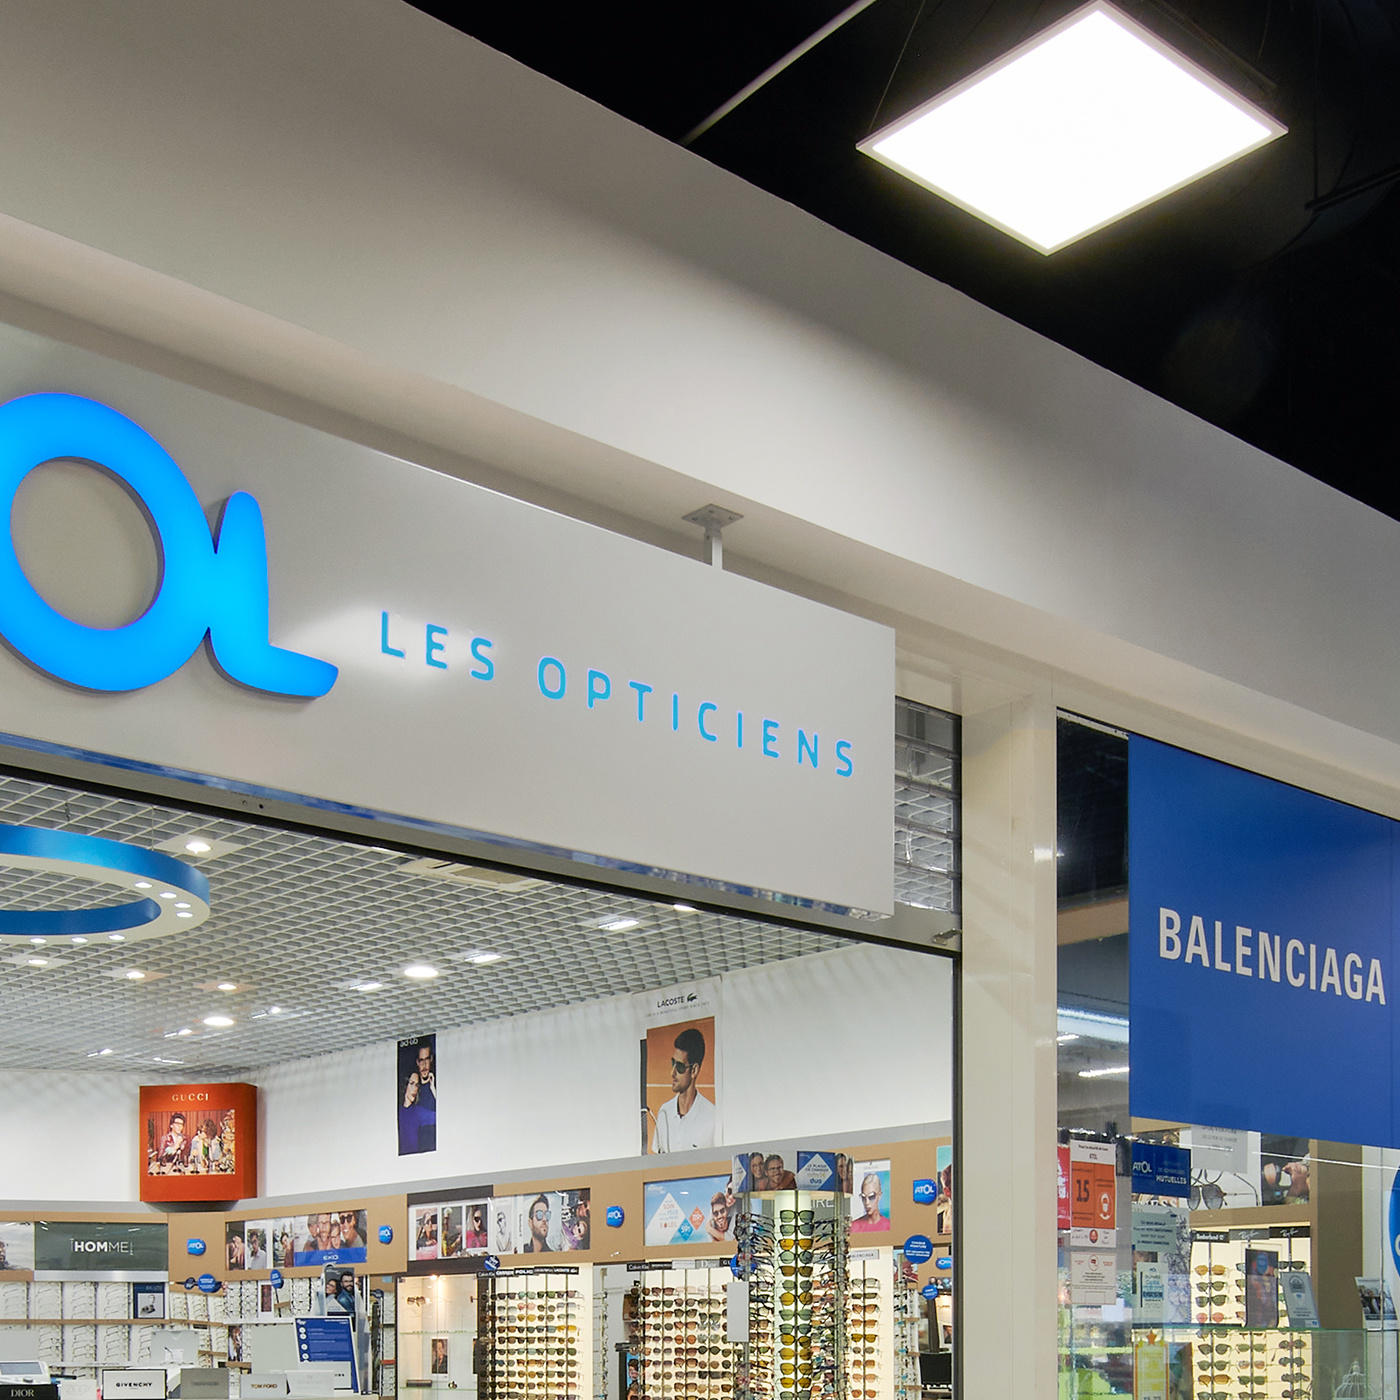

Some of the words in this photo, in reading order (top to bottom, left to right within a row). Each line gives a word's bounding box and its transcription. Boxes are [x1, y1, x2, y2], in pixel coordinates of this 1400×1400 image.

[378, 609, 497, 684] LES
[536, 655, 857, 779] OPTICIENS
[1158, 907, 1387, 1006] BALENCIAGA
[172, 1093, 209, 1101] GUCCI
[1133, 1161, 1152, 1173] ATOL
[74, 1240, 129, 1253] HOMME
[11, 1389, 35, 1397] DIOR
